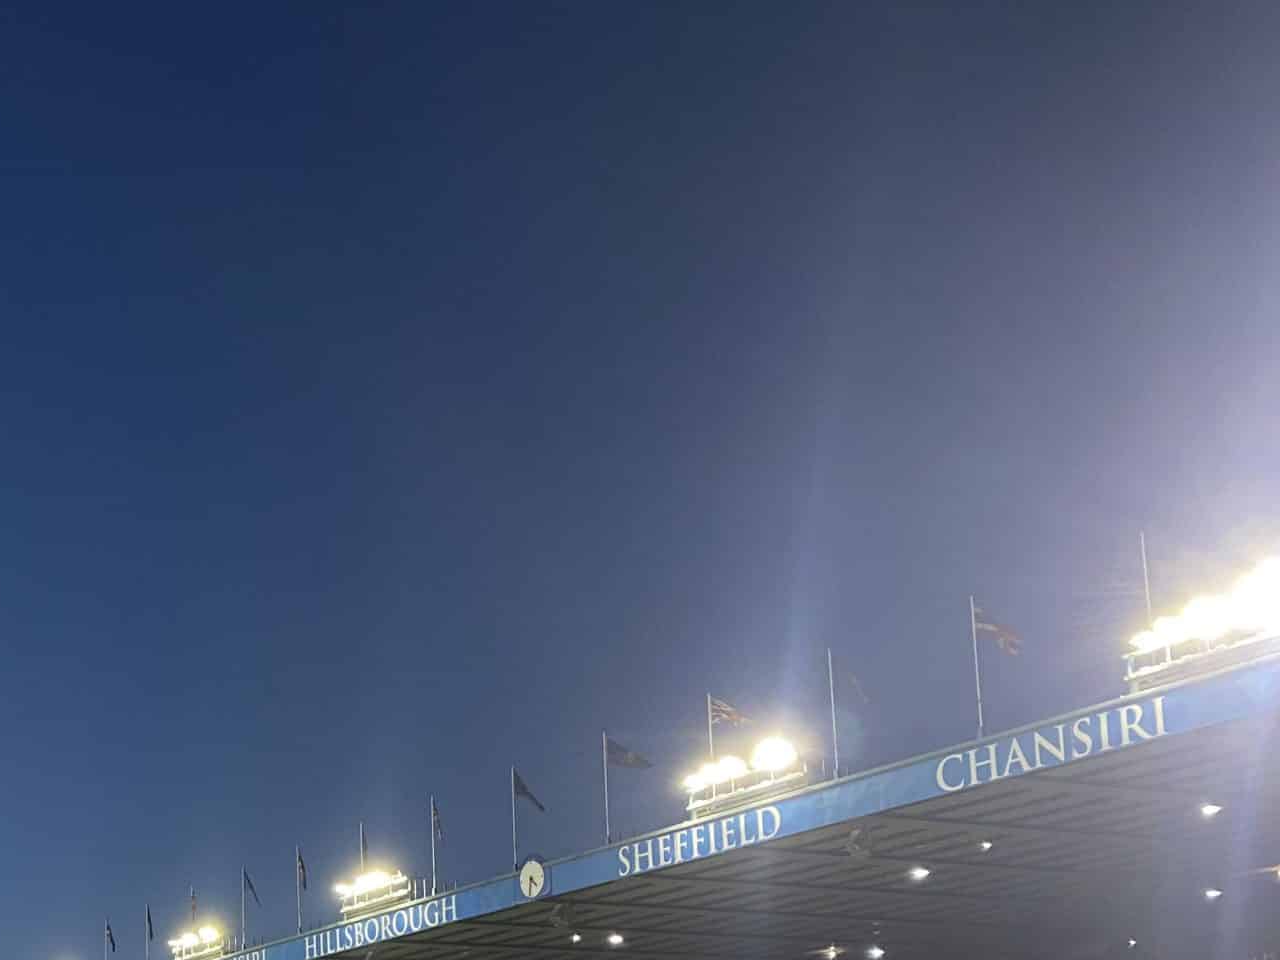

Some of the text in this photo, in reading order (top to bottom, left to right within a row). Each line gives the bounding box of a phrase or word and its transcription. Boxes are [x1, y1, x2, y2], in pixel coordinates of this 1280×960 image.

[936, 695, 1169, 792] CHANSIRI
[618, 805, 782, 877] SHEFFIELD
[304, 894, 458, 960] HILLSBOROUGH
